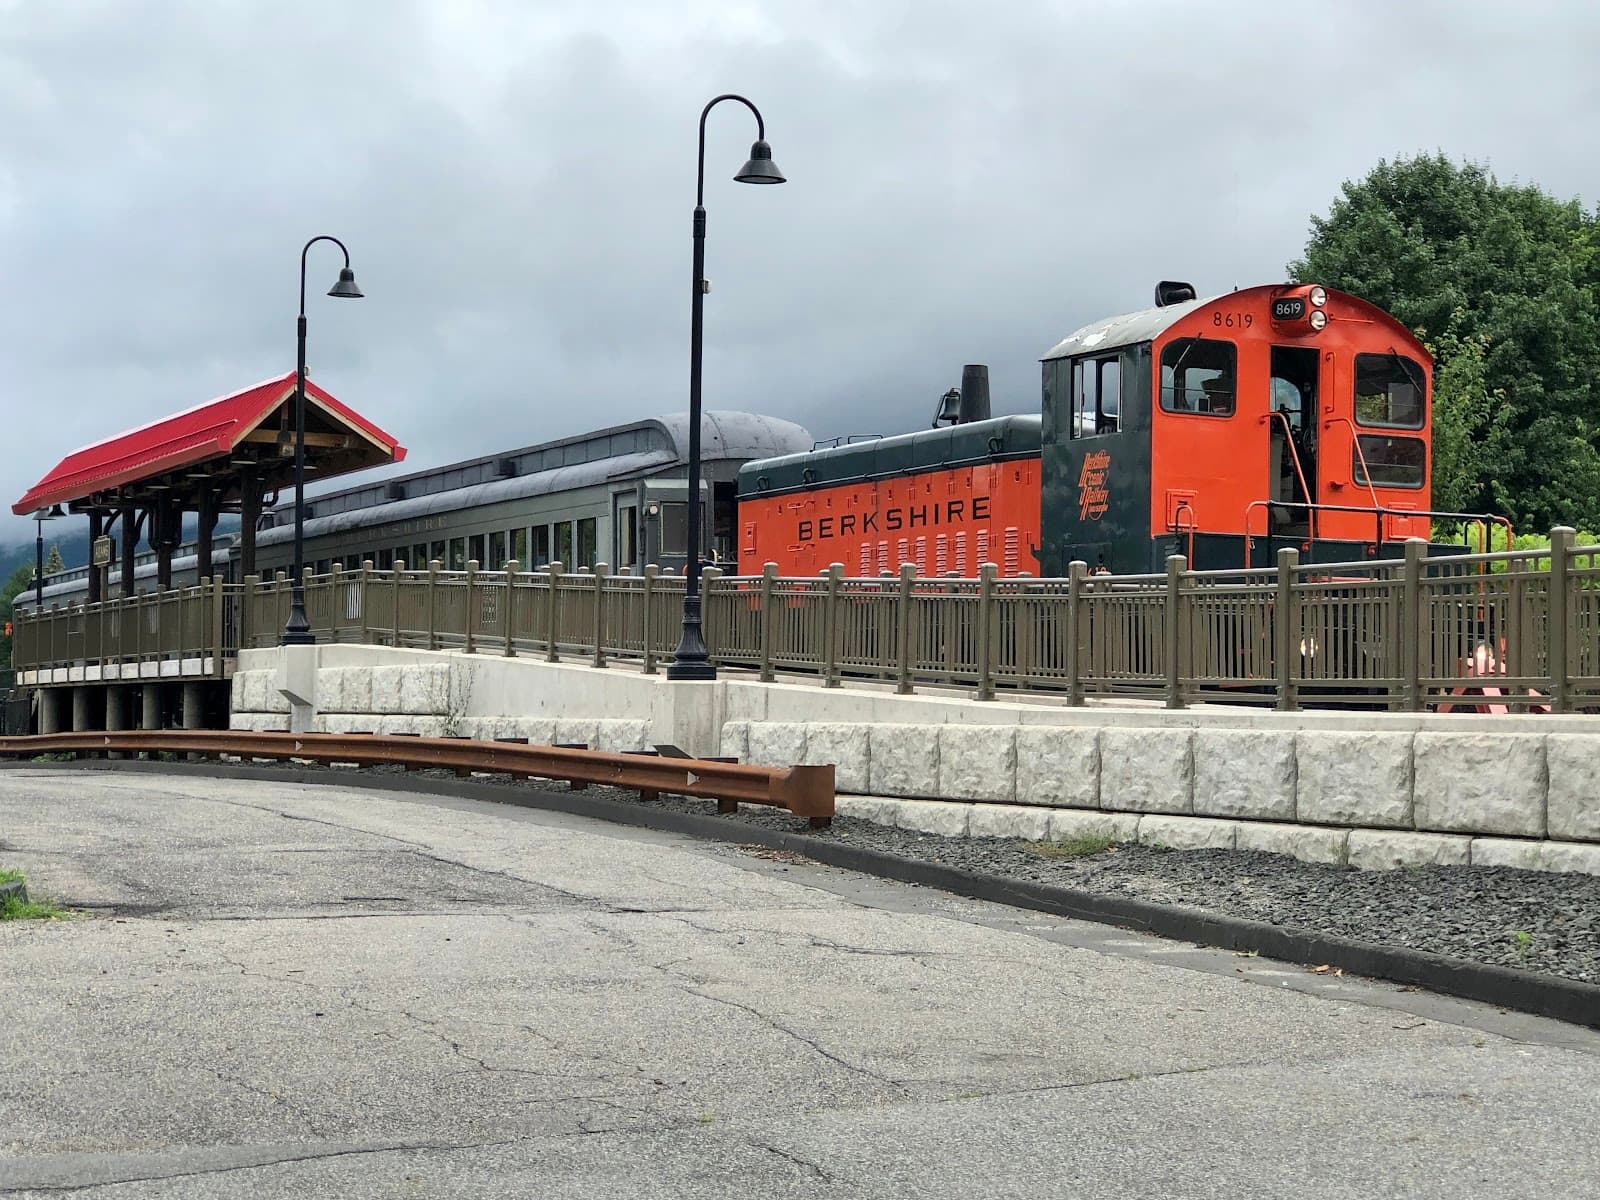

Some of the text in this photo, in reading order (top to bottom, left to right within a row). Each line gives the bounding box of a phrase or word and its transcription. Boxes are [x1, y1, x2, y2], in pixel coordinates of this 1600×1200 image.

[1276, 302, 1301, 315] 8619
[1213, 311, 1253, 329] 8619
[798, 496, 991, 541] BERKSHIRE
